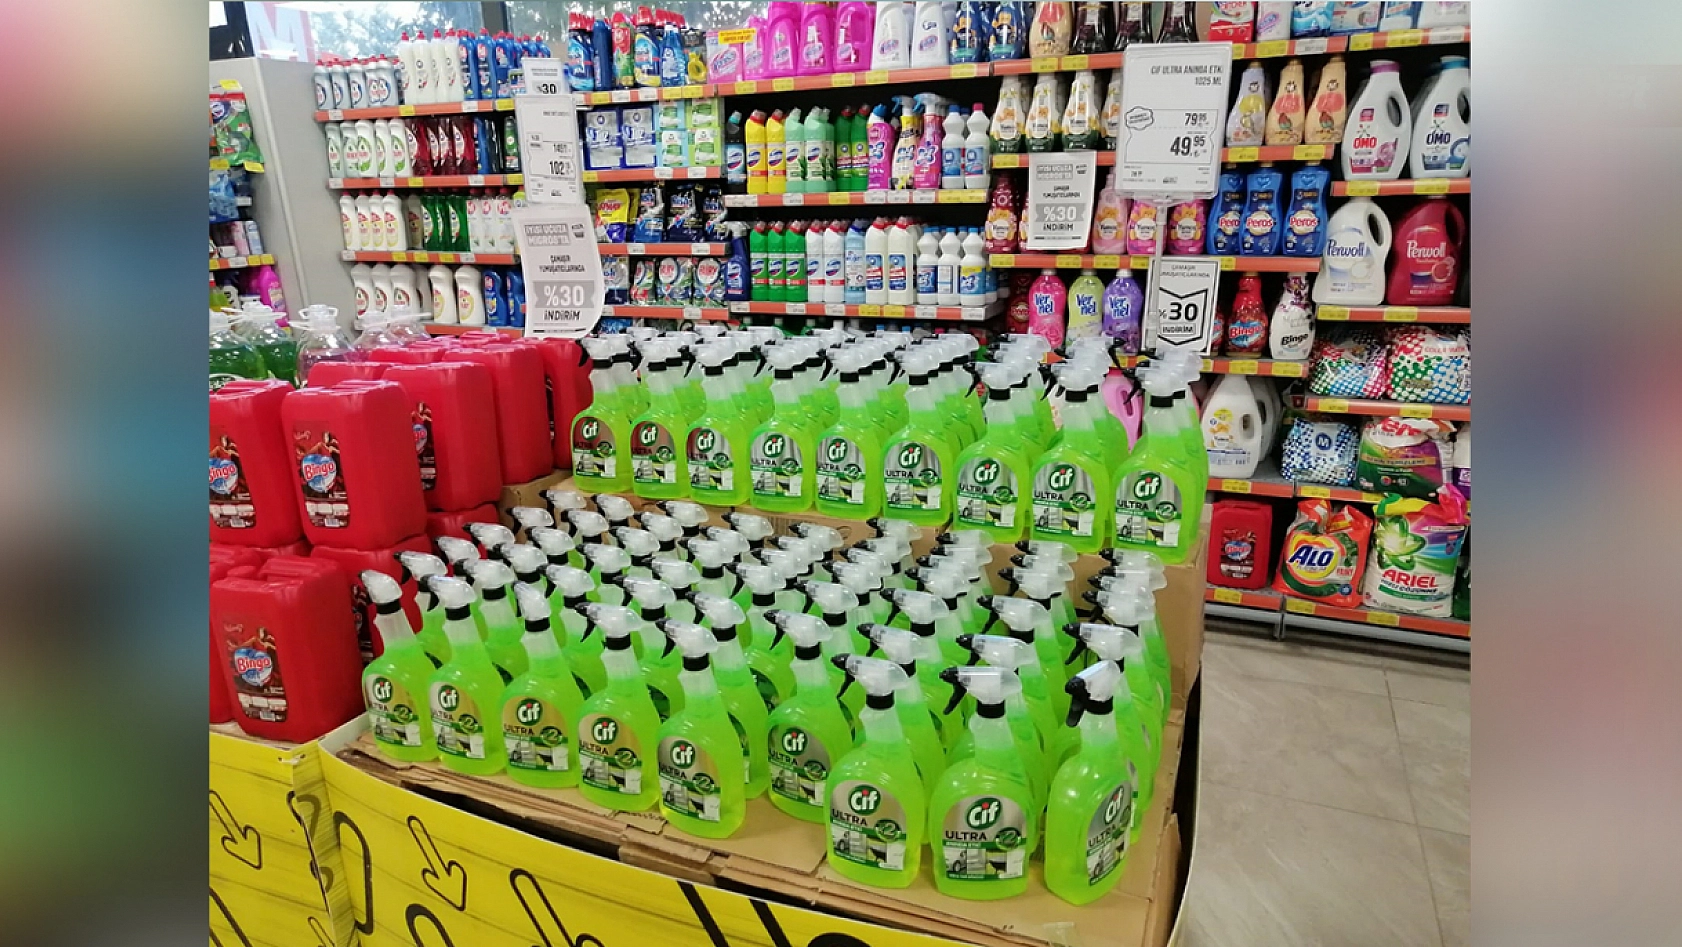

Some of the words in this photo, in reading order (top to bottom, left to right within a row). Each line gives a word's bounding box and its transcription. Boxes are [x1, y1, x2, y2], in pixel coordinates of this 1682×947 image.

[1353, 137, 1377, 149] OMO
[1426, 130, 1450, 145] OMO
[1043, 206, 1077, 222] %30
[1219, 217, 1241, 228] Pero
[1246, 217, 1273, 228] Peros
[1289, 216, 1318, 228] Peros
[1326, 239, 1365, 258] Perwoll
[1406, 239, 1446, 259] Perwoll
[543, 285, 584, 306] %30
[1281, 333, 1309, 347] Bingo
[582, 421, 599, 439] Cif
[640, 426, 657, 444] Cif
[697, 432, 714, 449] Cif
[764, 437, 783, 455] Cif
[828, 441, 846, 460] Cif
[900, 447, 921, 466] Cif
[302, 461, 335, 481] Bingo
[886, 469, 914, 479] ULTRA
[974, 463, 998, 482] Cif
[1050, 468, 1075, 487] Cif
[959, 484, 988, 495] ULTRA
[1134, 477, 1159, 496] Cif
[1033, 490, 1064, 502] ULTRA
[1116, 500, 1149, 511] ULTRA
[1288, 544, 1335, 567] ALO
[1381, 569, 1439, 589] ARIEL
[237, 656, 271, 673] Bingo
[375, 681, 391, 699] Cif
[440, 689, 458, 708] Cif
[517, 703, 540, 722] Cif
[503, 724, 534, 736] ULTRA
[593, 721, 616, 741] Cif
[579, 740, 609, 756] ULTRA
[782, 731, 805, 752] Cif
[672, 744, 693, 765] Cif
[769, 749, 798, 766] ULTRA
[850, 789, 878, 811] Cif
[1105, 786, 1124, 823] Cif
[832, 808, 868, 827] ULTRA
[968, 801, 999, 827] Cif
[945, 830, 987, 841] ULTRA
[1089, 823, 1116, 847] ULTRA
